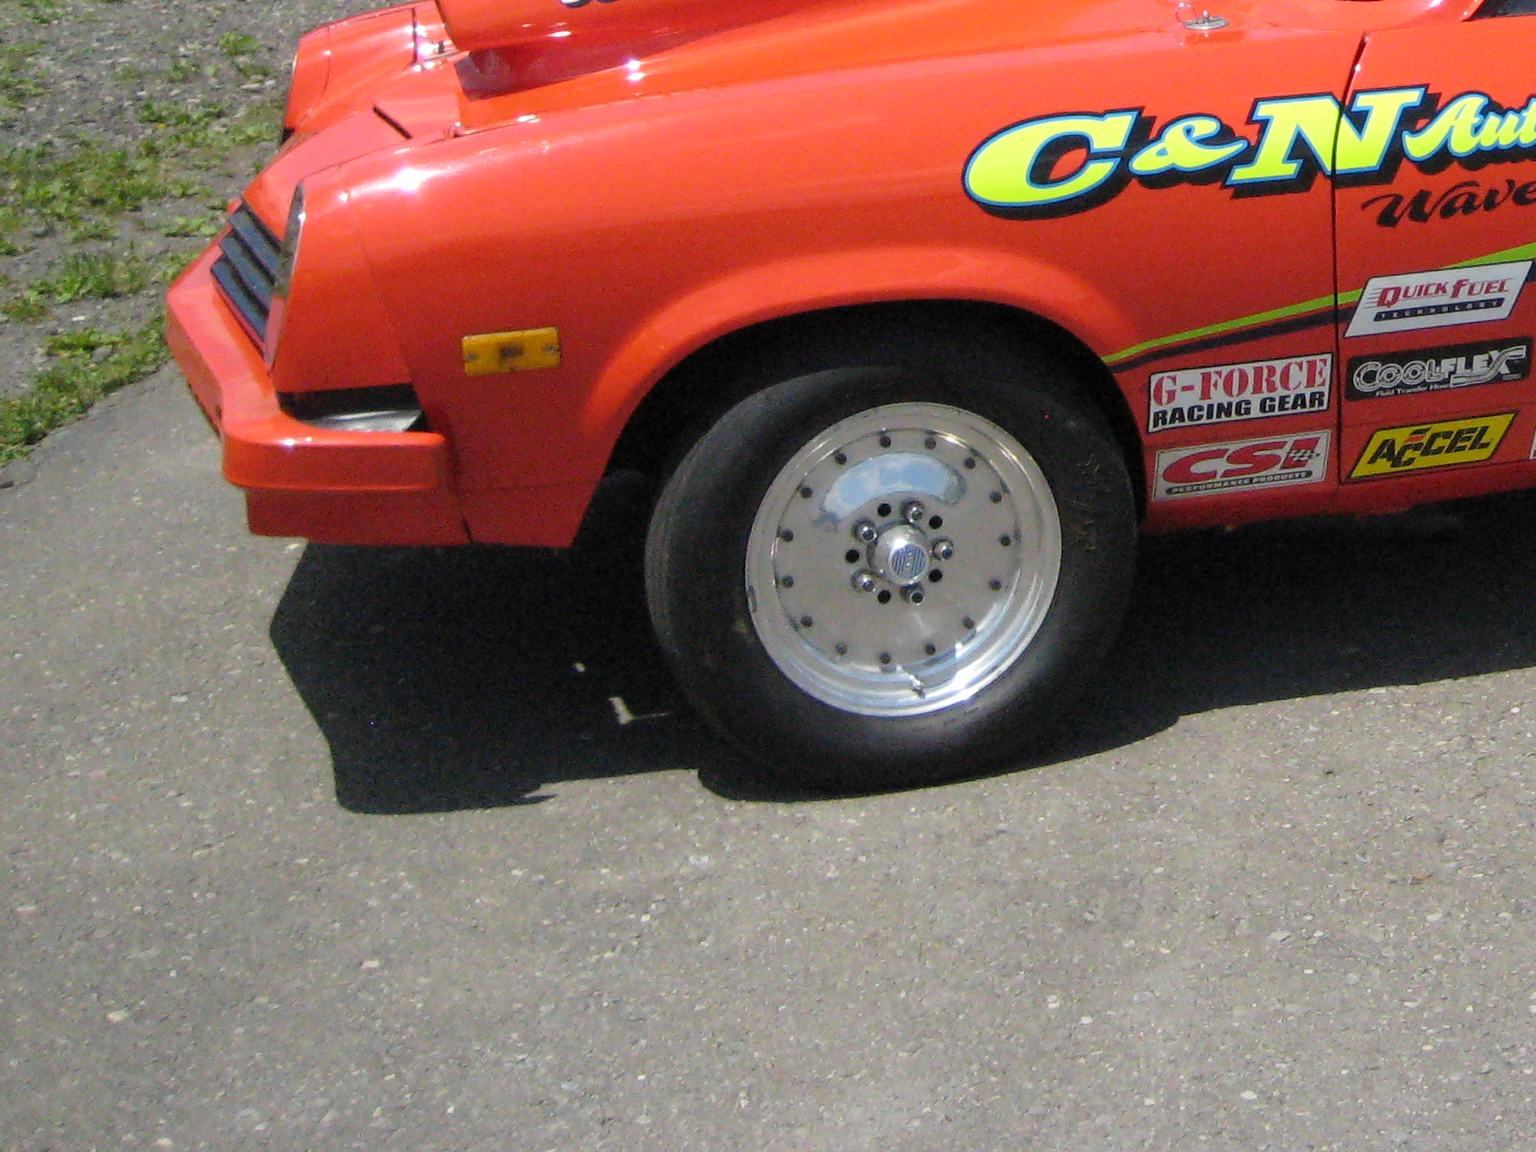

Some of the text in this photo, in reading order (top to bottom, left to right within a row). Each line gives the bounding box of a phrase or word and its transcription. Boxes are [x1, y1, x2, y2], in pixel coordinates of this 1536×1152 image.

[1376, 281, 1450, 308] QUICK
[1379, 300, 1499, 319] TECHNOLOGY
[1153, 358, 1328, 407] G-FORCE
[1353, 345, 1526, 393] COOLFLEX
[1152, 391, 1326, 429] RACING GEAR
[1368, 425, 1493, 468] ACCEL
[1171, 471, 1307, 493] PERFORMANCE PRODUCTS
